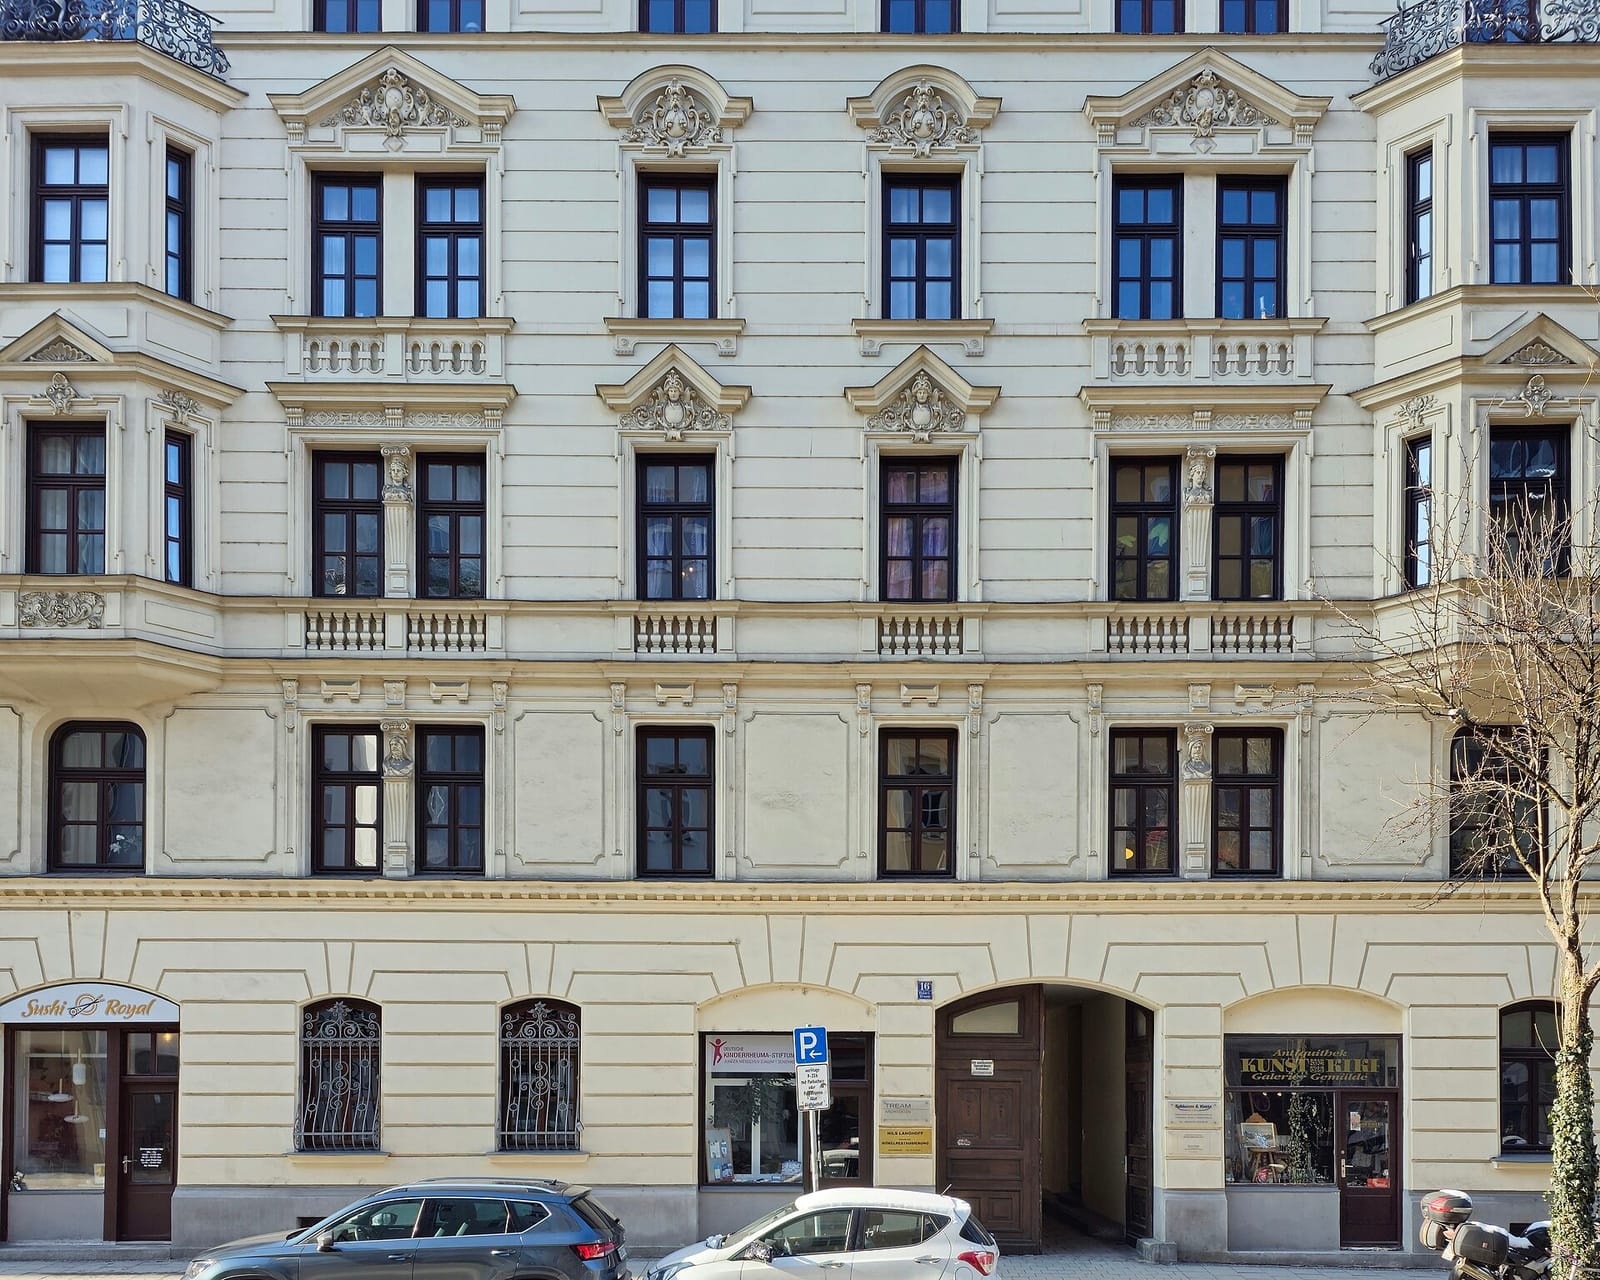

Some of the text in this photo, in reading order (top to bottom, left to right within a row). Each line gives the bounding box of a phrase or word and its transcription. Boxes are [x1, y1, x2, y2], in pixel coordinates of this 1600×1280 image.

[920, 982, 930, 991] 16
[21, 998, 157, 1020] Sushi Royal
[799, 1032, 817, 1060] P
[1240, 1058, 1309, 1073] KUNST
[1326, 1058, 1379, 1073] KIKI
[1251, 1072, 1368, 1081] Galerie Gemälde
